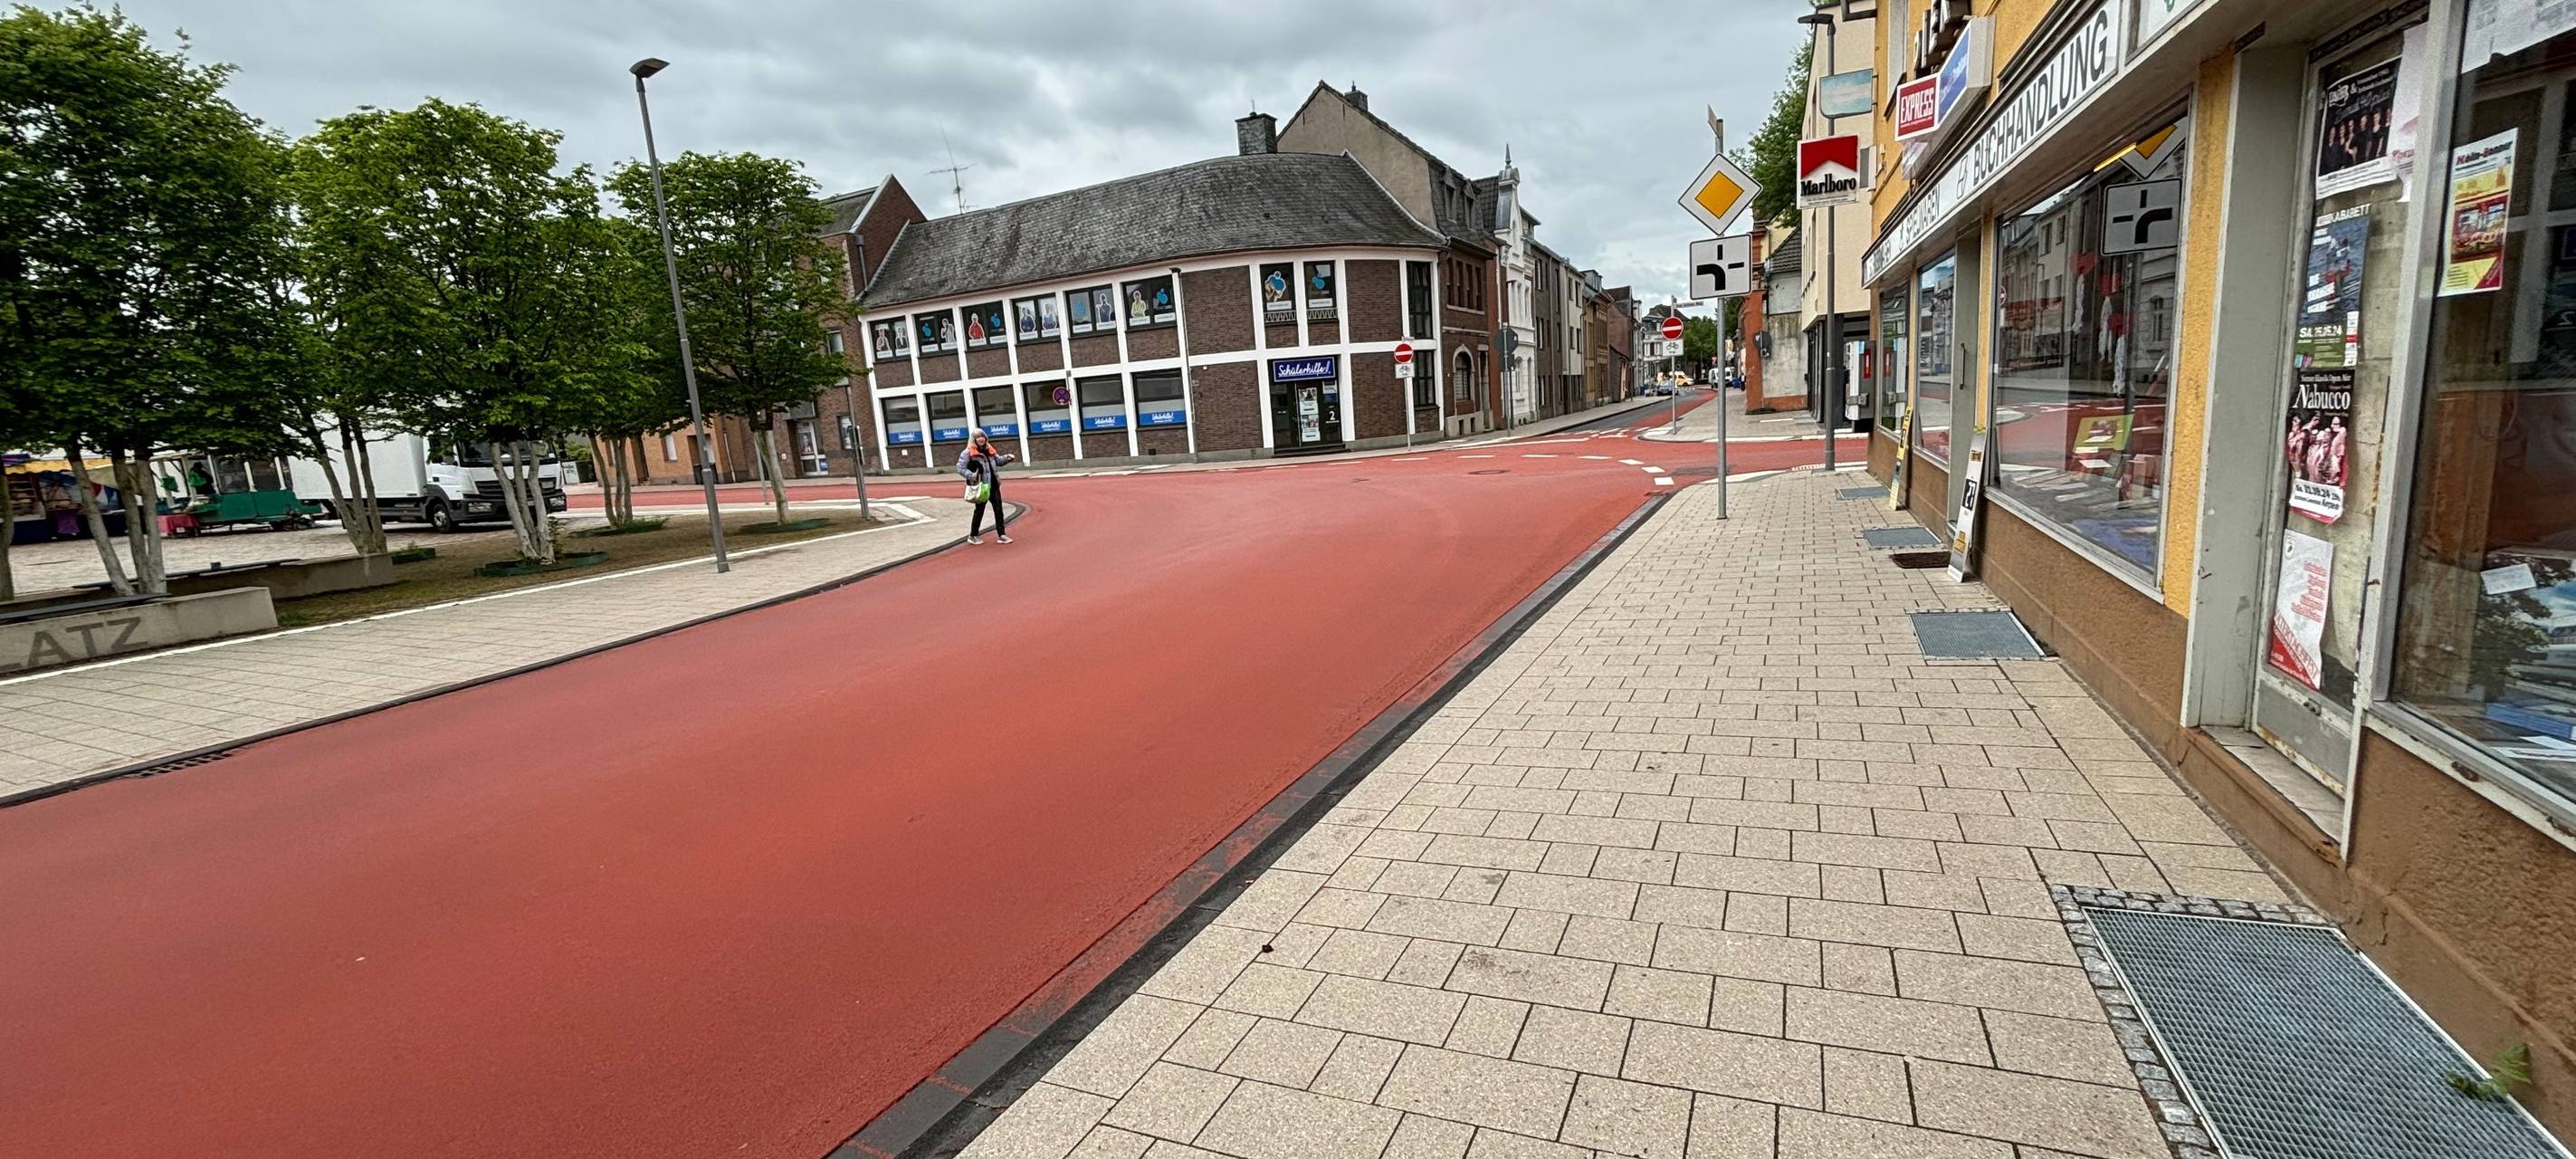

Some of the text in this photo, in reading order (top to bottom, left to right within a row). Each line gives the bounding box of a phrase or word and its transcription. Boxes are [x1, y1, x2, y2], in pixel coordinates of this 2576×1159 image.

[1901, 87, 1933, 124] EXPRESS
[1973, 10, 2108, 187] BUCHHANDLUNG
[1800, 173, 1857, 196] Marlboro
[1278, 360, 1331, 378] Schülerhilfe!
[2292, 383, 2351, 410] Nabucco
[1329, 410, 1336, 421] 2
